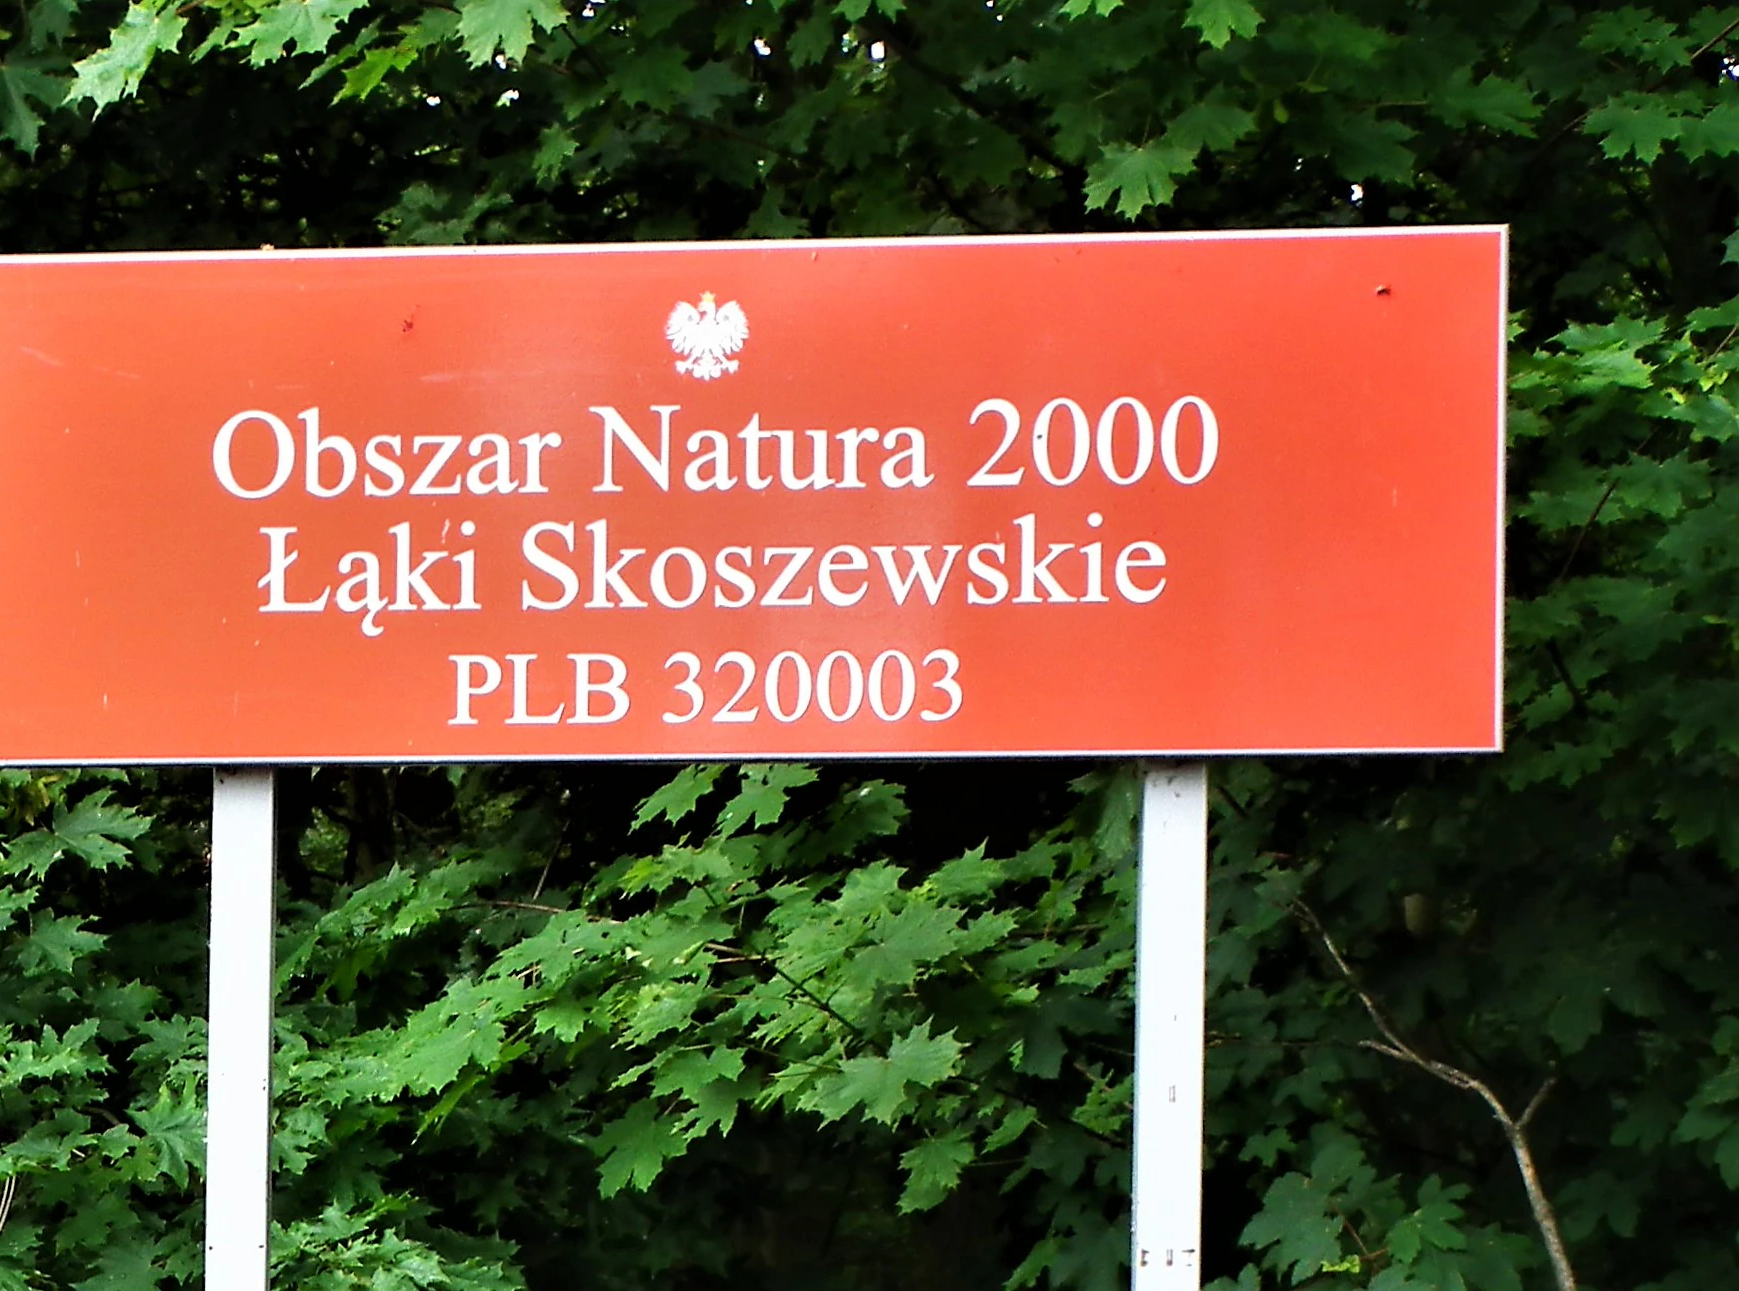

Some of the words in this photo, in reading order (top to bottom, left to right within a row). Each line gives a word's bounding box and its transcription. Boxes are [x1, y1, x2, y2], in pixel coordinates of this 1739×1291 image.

[211, 407, 564, 500] Obszar
[587, 404, 936, 494] Natura
[965, 394, 1220, 490] 2000
[256, 518, 483, 638] Łąki
[520, 511, 1168, 612] Skoszewskie
[446, 652, 631, 728] PLB
[660, 649, 964, 725] 320003
